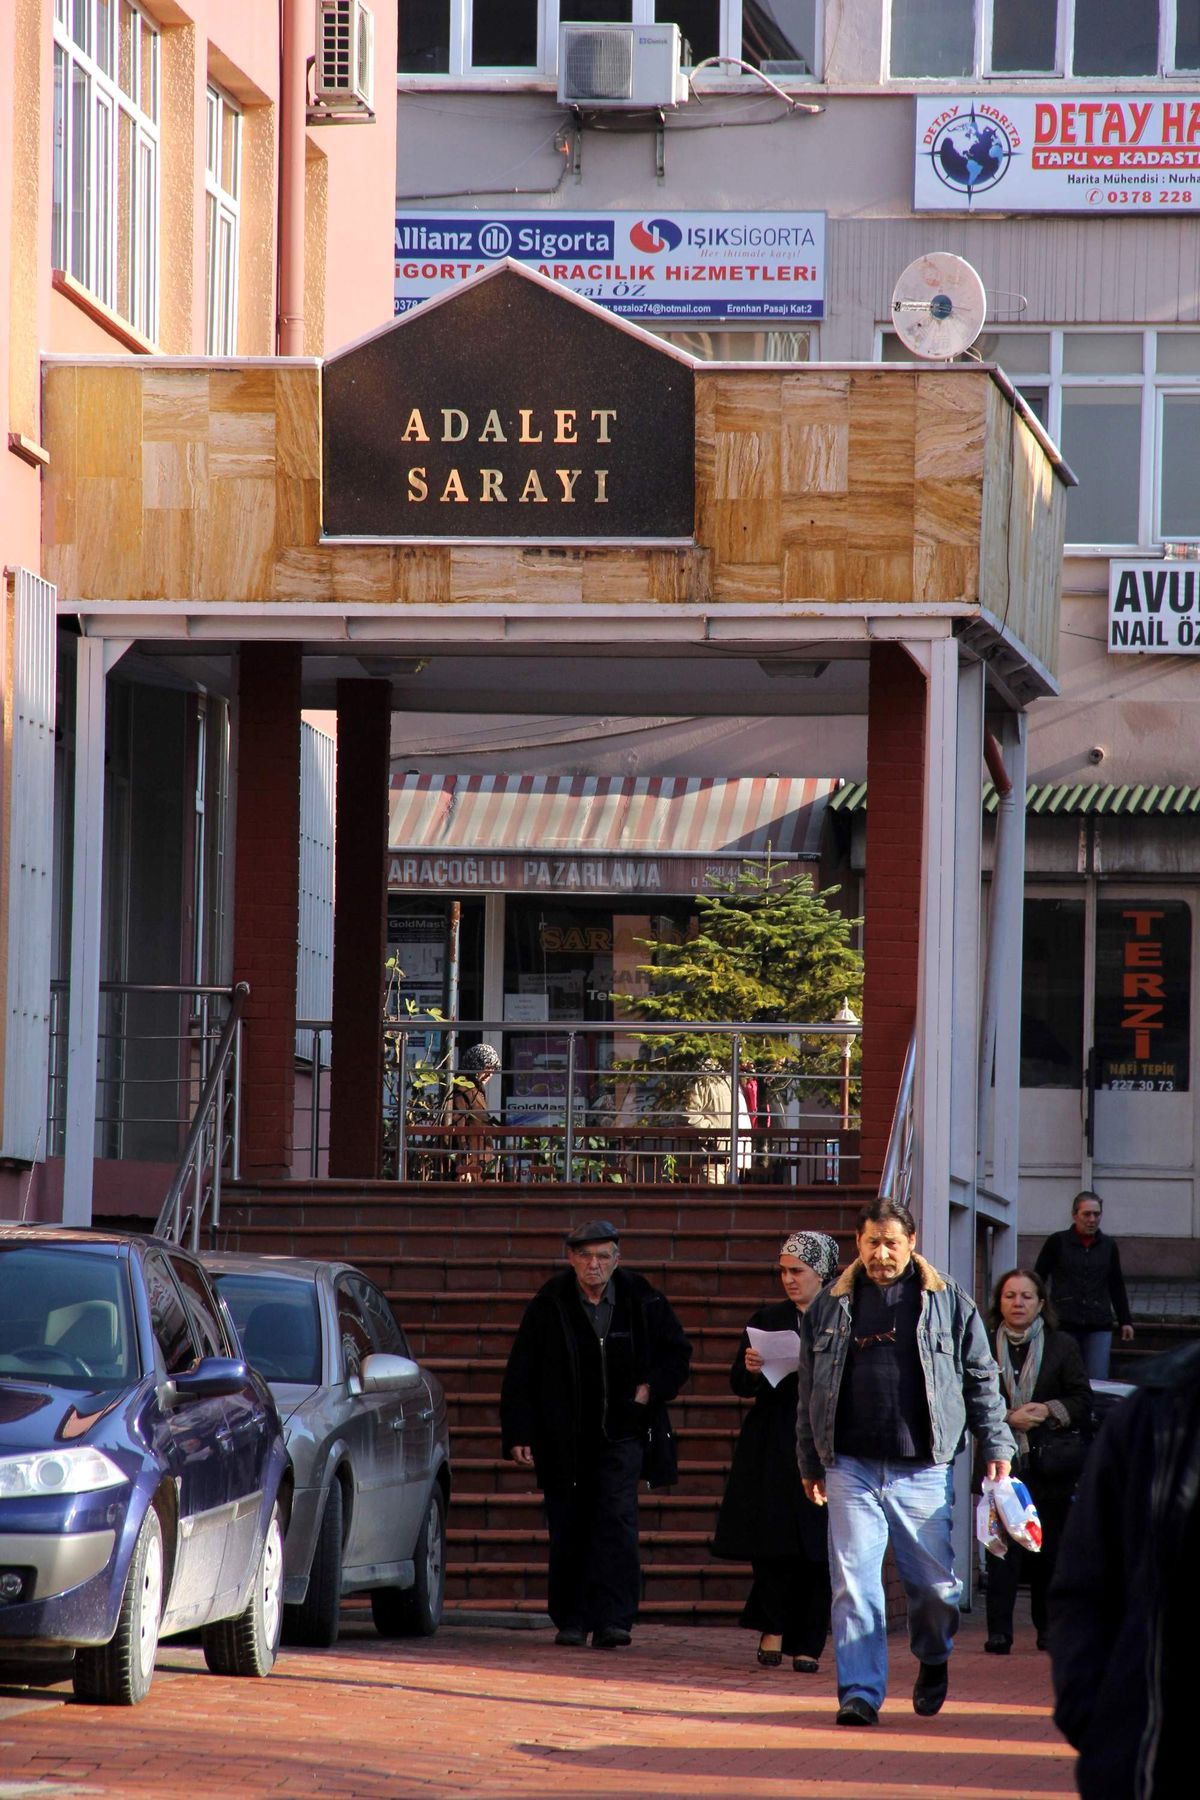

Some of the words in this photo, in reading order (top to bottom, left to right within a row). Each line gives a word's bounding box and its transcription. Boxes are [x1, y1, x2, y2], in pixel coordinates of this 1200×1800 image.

[923, 105, 960, 145] DETAY
[1034, 103, 1154, 145] DETAY
[1036, 151, 1088, 165] TAPU
[1094, 154, 1113, 165] ve
[1119, 151, 1200, 165] KADAST
[1067, 173, 1100, 184] Harita
[1103, 173, 1159, 184] Mühendisi
[1108, 190, 1152, 203] 0378
[1159, 190, 1192, 203] 228
[394, 227, 472, 250] Allianz
[518, 228, 610, 257] Sigorta
[701, 249, 718, 258] Her
[538, 264, 656, 280] ARACILIK
[573, 284, 603, 296] zai
[612, 281, 647, 297] ÖZ
[612, 303, 711, 314] sezaioz74@hotmail.com
[727, 304, 762, 313] Erenhan
[790, 304, 812, 313] Kat:2
[401, 408, 617, 443] ADALET
[407, 467, 609, 503] SARAYI
[1113, 571, 1200, 613] AVU
[1111, 616, 1169, 646] NAİL
[388, 857, 505, 886] ARAÇOĞLU
[523, 861, 661, 887] PAZARLAMA
[389, 919, 446, 928] GoldMast
[1111, 1080, 1135, 1091] 227
[1139, 1080, 1154, 1091] 30
[1158, 1080, 1174, 1091] 73
[507, 1103, 584, 1112] GoldMasr
